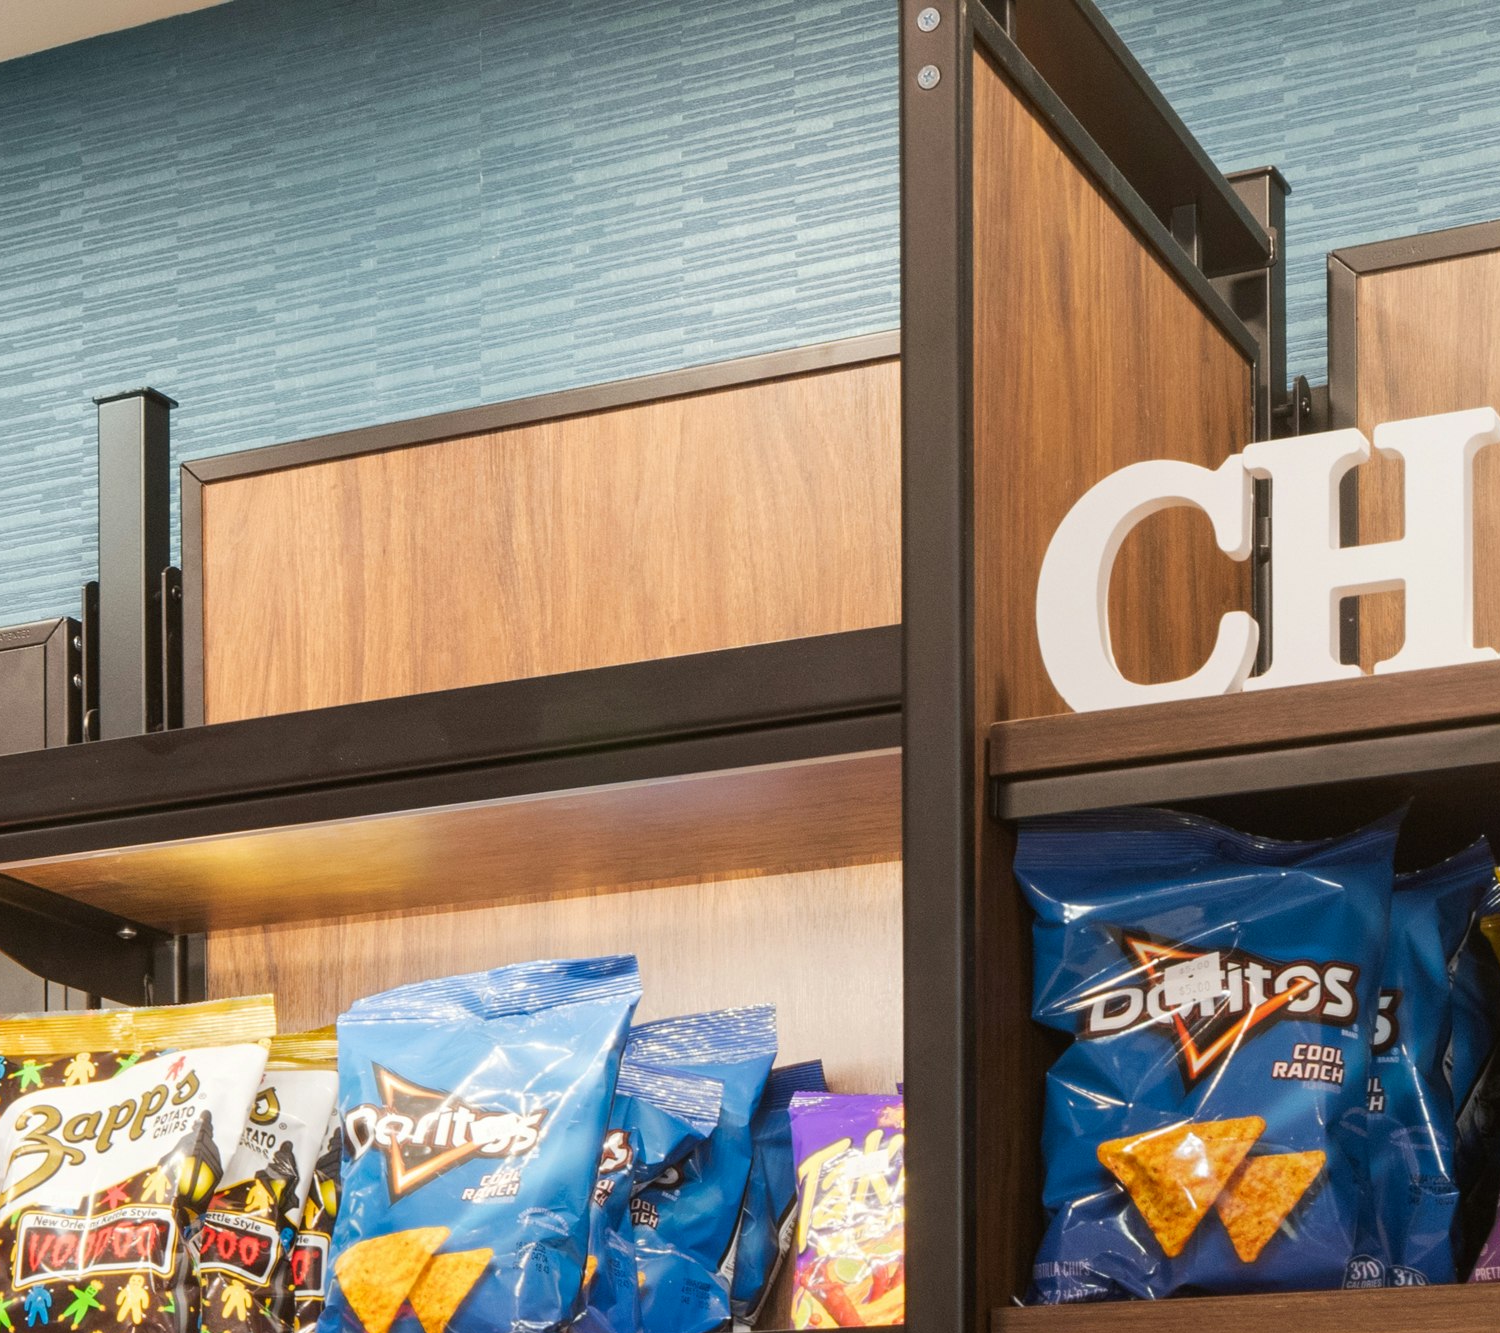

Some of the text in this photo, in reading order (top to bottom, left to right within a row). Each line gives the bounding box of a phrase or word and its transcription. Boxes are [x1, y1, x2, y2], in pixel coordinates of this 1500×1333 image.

[1293, 1044, 1343, 1064] COOL
[1272, 1060, 1344, 1085] RANCH
[153, 1106, 195, 1127] POTATO
[153, 1121, 187, 1140] CHIPS
[346, 1104, 548, 1159] Doritos
[479, 1169, 520, 1186] COOL
[462, 1181, 519, 1202] RANCH
[34, 1209, 158, 1226] New Style
[28, 1220, 156, 1271] VOODOO
